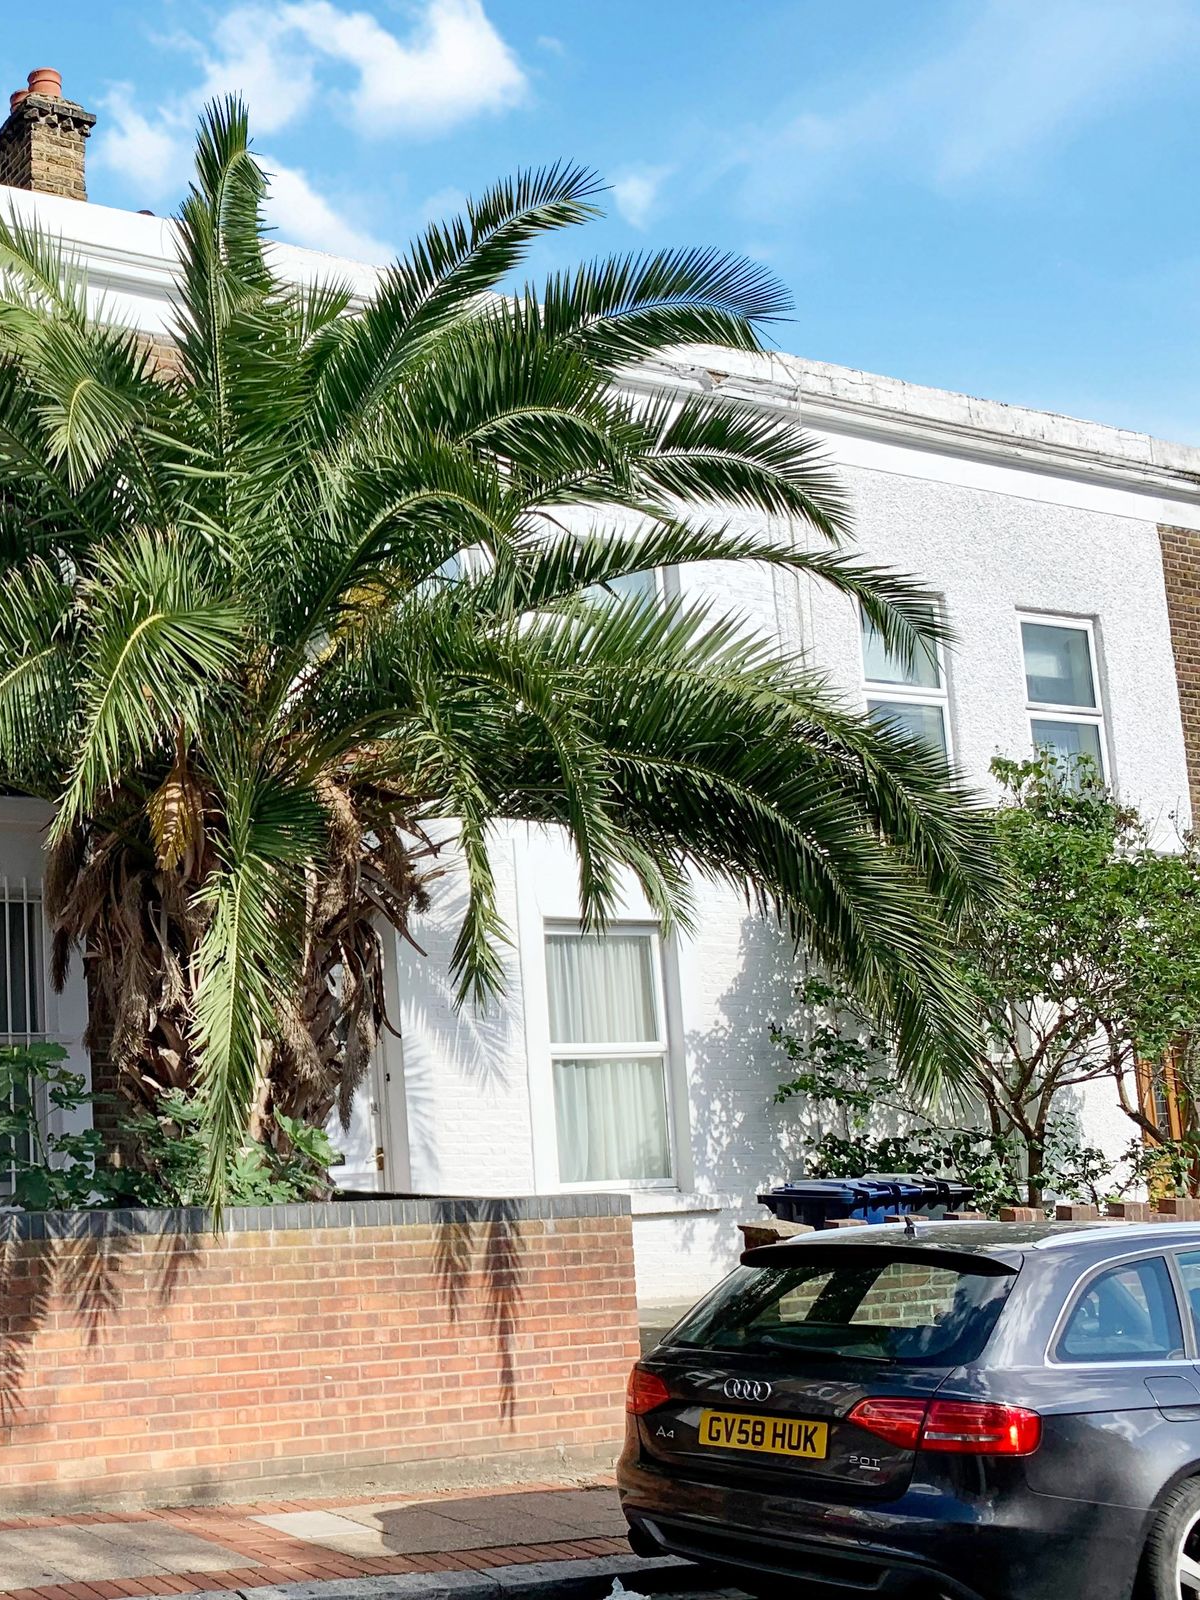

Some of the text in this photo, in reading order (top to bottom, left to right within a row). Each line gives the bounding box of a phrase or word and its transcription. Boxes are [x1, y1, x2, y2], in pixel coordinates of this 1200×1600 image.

[656, 1425, 674, 1438] A4
[708, 1416, 819, 1453] GV58 HUK
